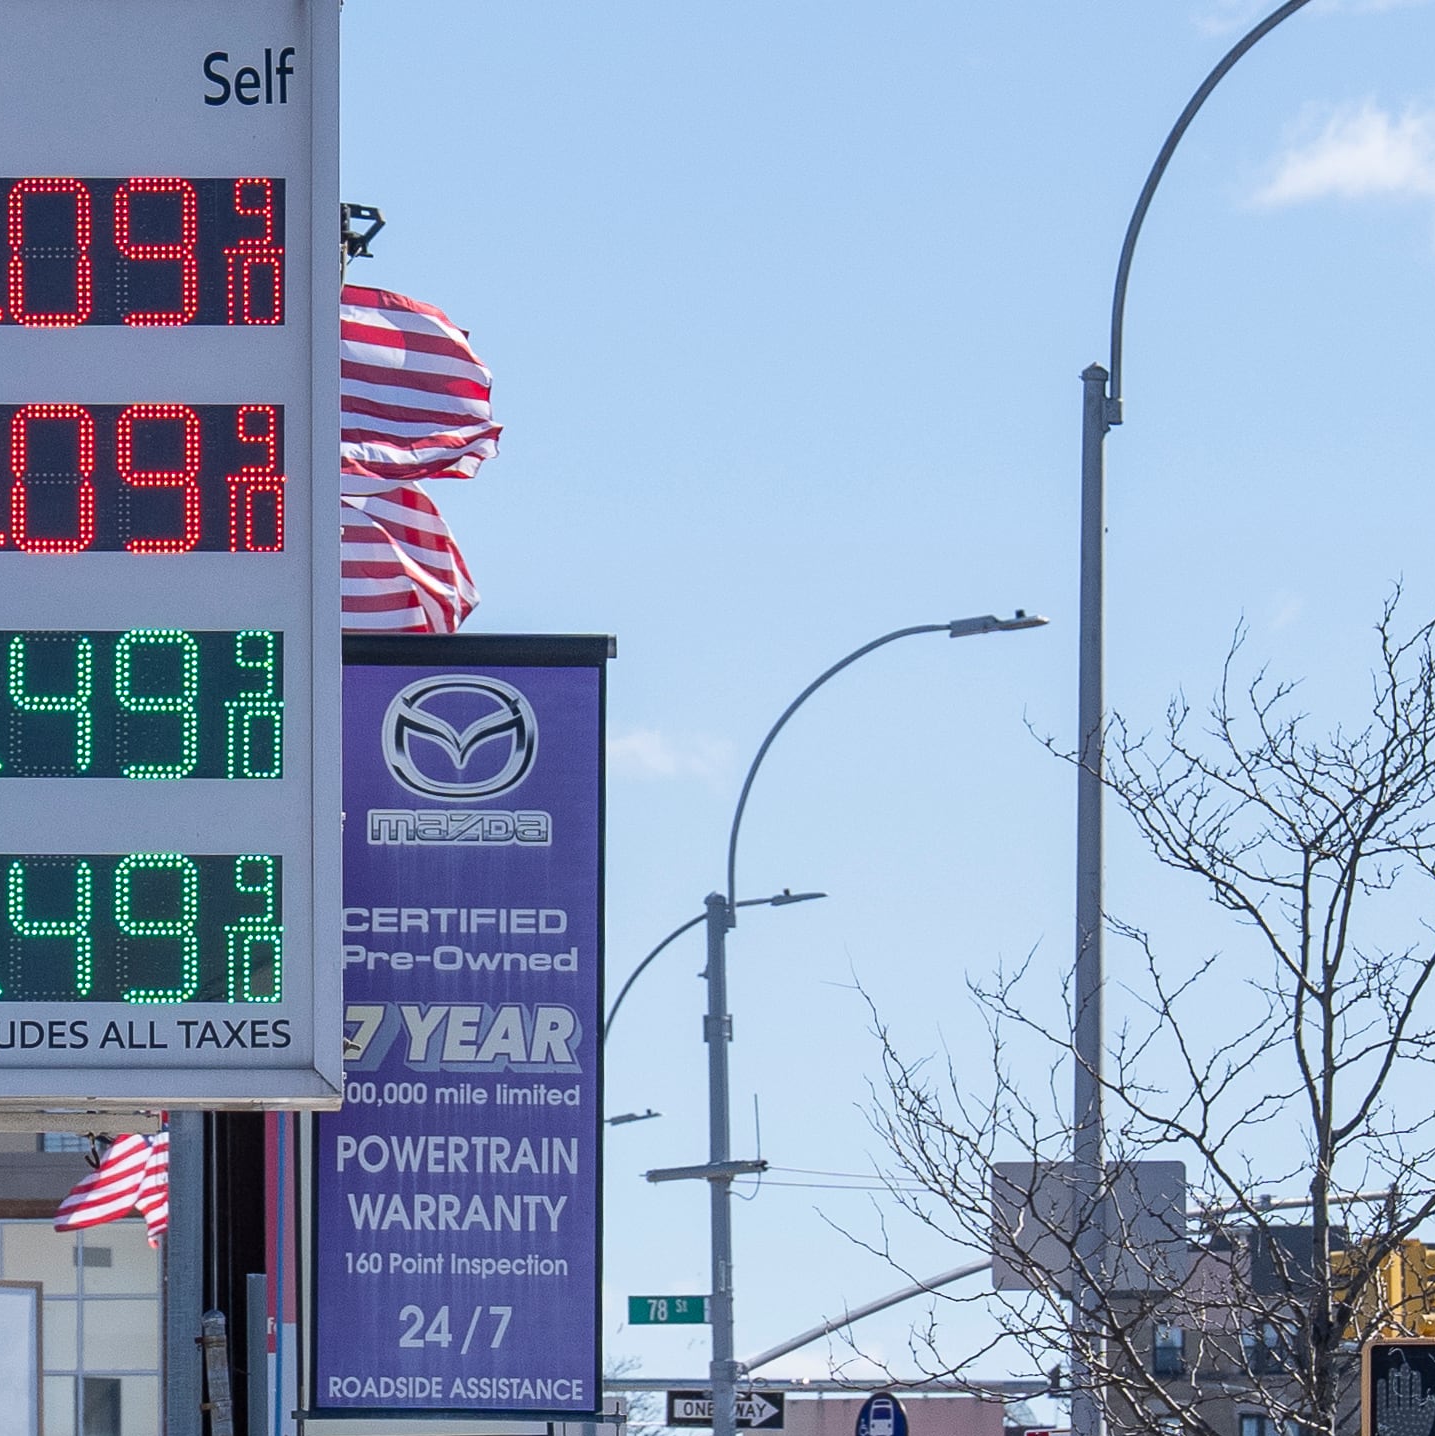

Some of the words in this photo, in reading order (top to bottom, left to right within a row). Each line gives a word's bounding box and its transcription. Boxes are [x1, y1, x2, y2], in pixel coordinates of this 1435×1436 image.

[202, 46, 296, 106] Self
[342, 907, 568, 935] CERTIFIED
[342, 944, 579, 973] Pre-Owned
[99, 1020, 167, 1050] ALL
[177, 1020, 292, 1050] TAXES
[343, 1004, 387, 1062] 7
[400, 1003, 579, 1066] YEAR
[346, 1081, 428, 1108] 00,000
[435, 1082, 489, 1107] mile
[495, 1083, 581, 1107] limited
[335, 1134, 580, 1175] POWERTRAIN
[347, 1193, 569, 1232] WARRANTY
[345, 1252, 383, 1276] 160
[389, 1252, 444, 1276] Point
[450, 1253, 569, 1279] Inspection
[647, 1298, 669, 1322] 78
[675, 1298, 688, 1314] St
[328, 1376, 443, 1399] ROADSIDE
[449, 1377, 584, 1401] ASSISTANCE
[683, 1401, 714, 1417] ONE
[735, 1402, 767, 1417] WAY
